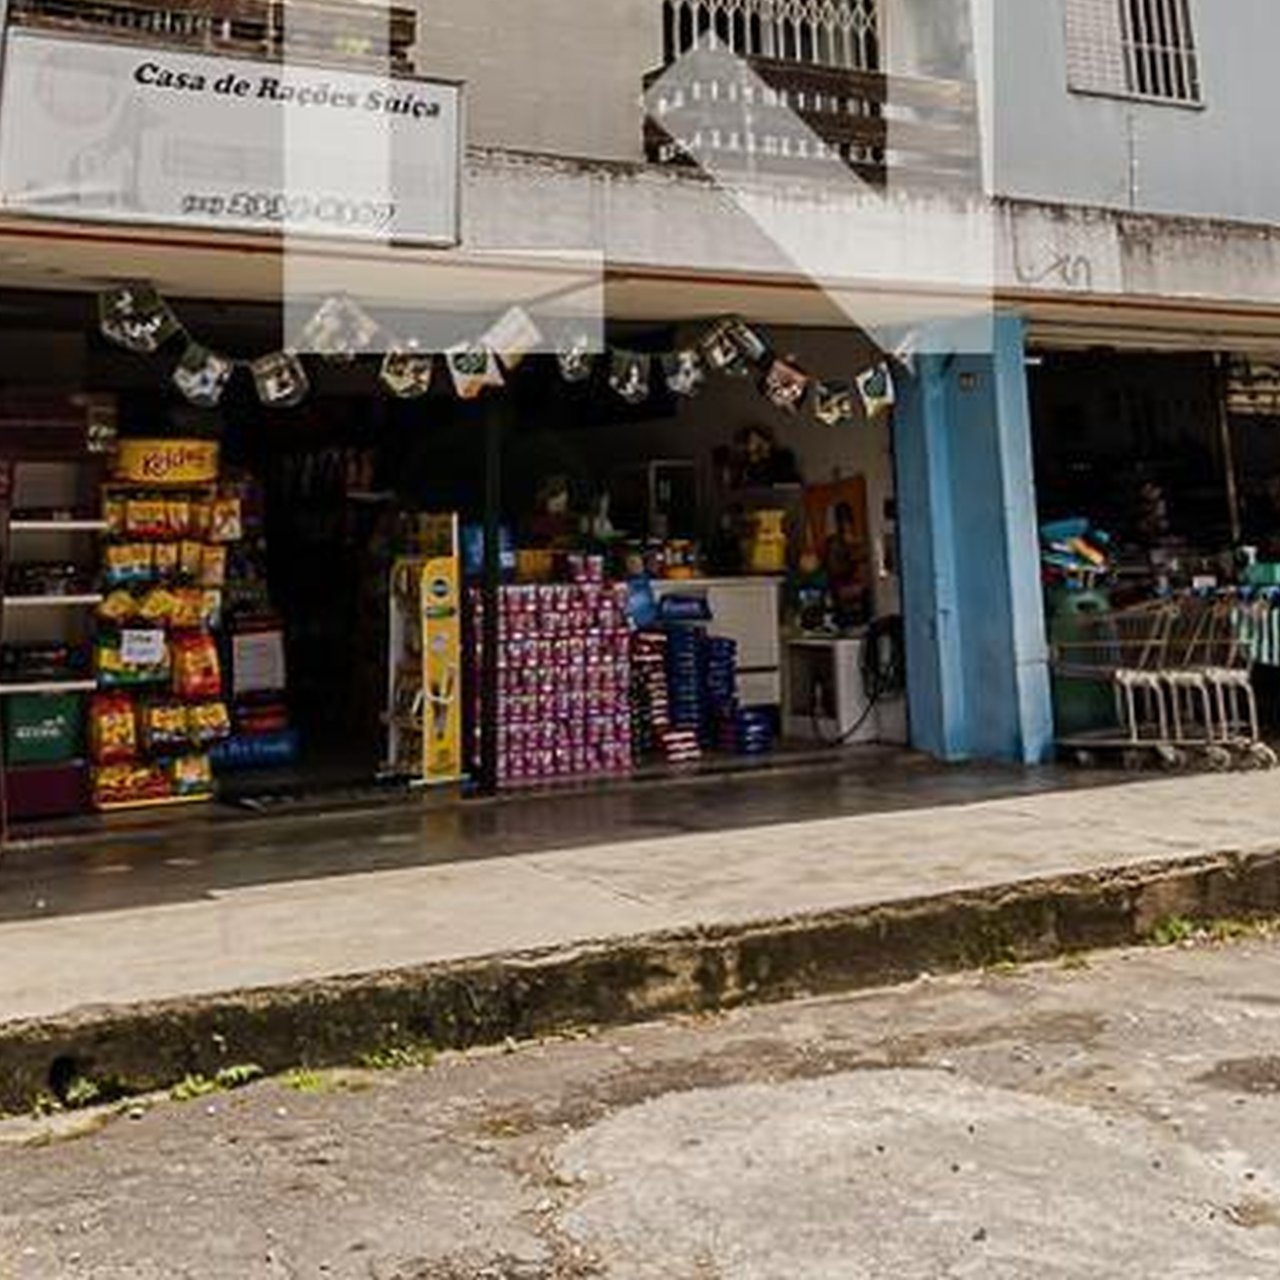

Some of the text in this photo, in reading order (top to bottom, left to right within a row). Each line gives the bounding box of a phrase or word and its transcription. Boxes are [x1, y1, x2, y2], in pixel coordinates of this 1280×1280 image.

[134, 62, 206, 91] Casa
[214, 74, 251, 97] de
[256, 77, 358, 107] Rações
